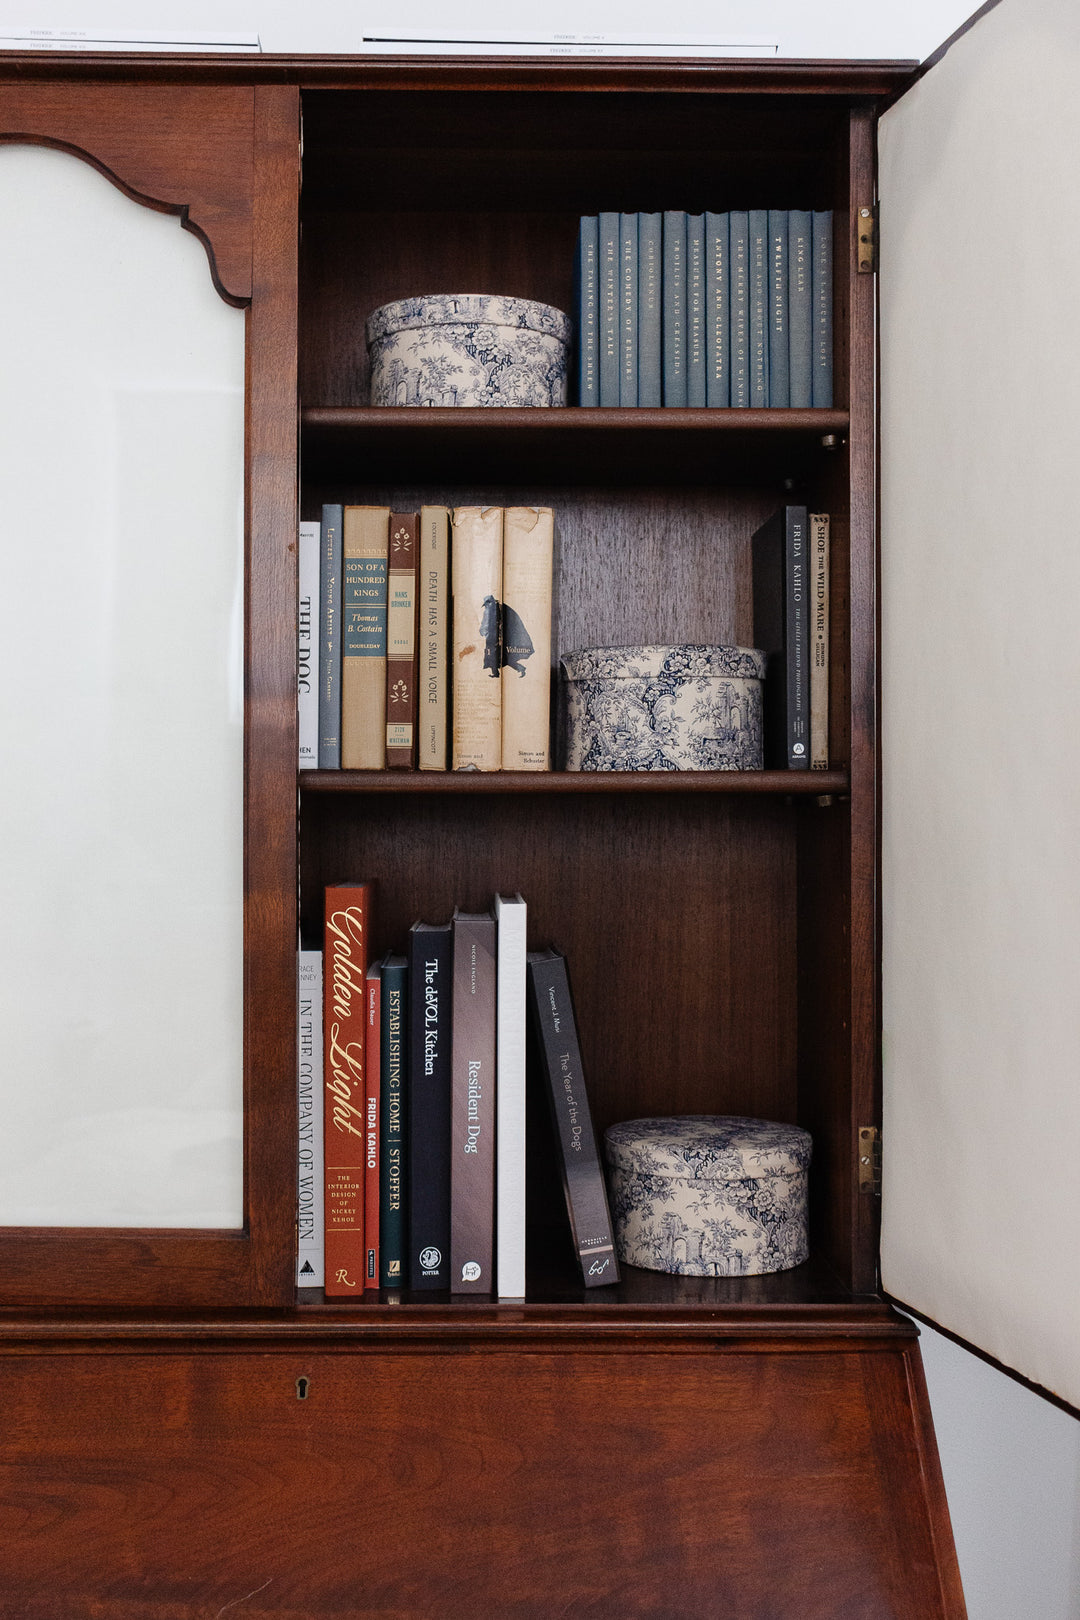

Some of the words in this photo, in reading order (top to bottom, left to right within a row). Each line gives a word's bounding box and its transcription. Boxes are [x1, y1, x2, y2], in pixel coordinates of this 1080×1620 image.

[587, 314, 593, 325] OF
[625, 320, 631, 332] OF
[738, 350, 744, 361] OF
[793, 525, 801, 557] FRIDA
[817, 527, 825, 552] SHOE
[346, 563, 363, 571] SON
[366, 563, 377, 571] OF
[354, 589, 379, 597] KINGS
[428, 572, 438, 602] DEATH
[793, 565, 802, 601] KAHLO
[817, 572, 825, 598] WILD
[299, 597, 310, 639] THE
[348, 625, 355, 633] B.
[357, 624, 382, 633] Costain
[352, 613, 378, 622] Thomas
[428, 608, 438, 625] HAS
[428, 642, 437, 671] SMALL
[506, 646, 531, 654] Volume
[299, 647, 310, 694] DOG
[428, 676, 437, 704] VOICE
[327, 906, 362, 1020] Golden
[424, 959, 438, 984] The
[300, 999, 313, 1016] IN
[425, 986, 438, 1027] deVOL
[548, 987, 557, 1011] Vincent
[299, 1021, 313, 1056] THE
[389, 990, 400, 1088] ESTABLISHING
[424, 1029, 438, 1076] Kitchen
[559, 1053, 570, 1070] The
[327, 1022, 362, 1137] Light
[468, 1060, 481, 1121] Resident
[563, 1072, 574, 1093] Year
[298, 1063, 314, 1142] COMPANY
[389, 1092, 400, 1133] HOME
[567, 1095, 577, 1105] of
[367, 1098, 377, 1131] FRIDA
[568, 1108, 578, 1124] the
[367, 1133, 377, 1168] KAHLO
[464, 1126, 481, 1154] Dog
[570, 1126, 583, 1152] Dogs
[298, 1149, 314, 1171] OF
[389, 1149, 400, 1212] STOFFER
[298, 1175, 314, 1240] WOMEN
